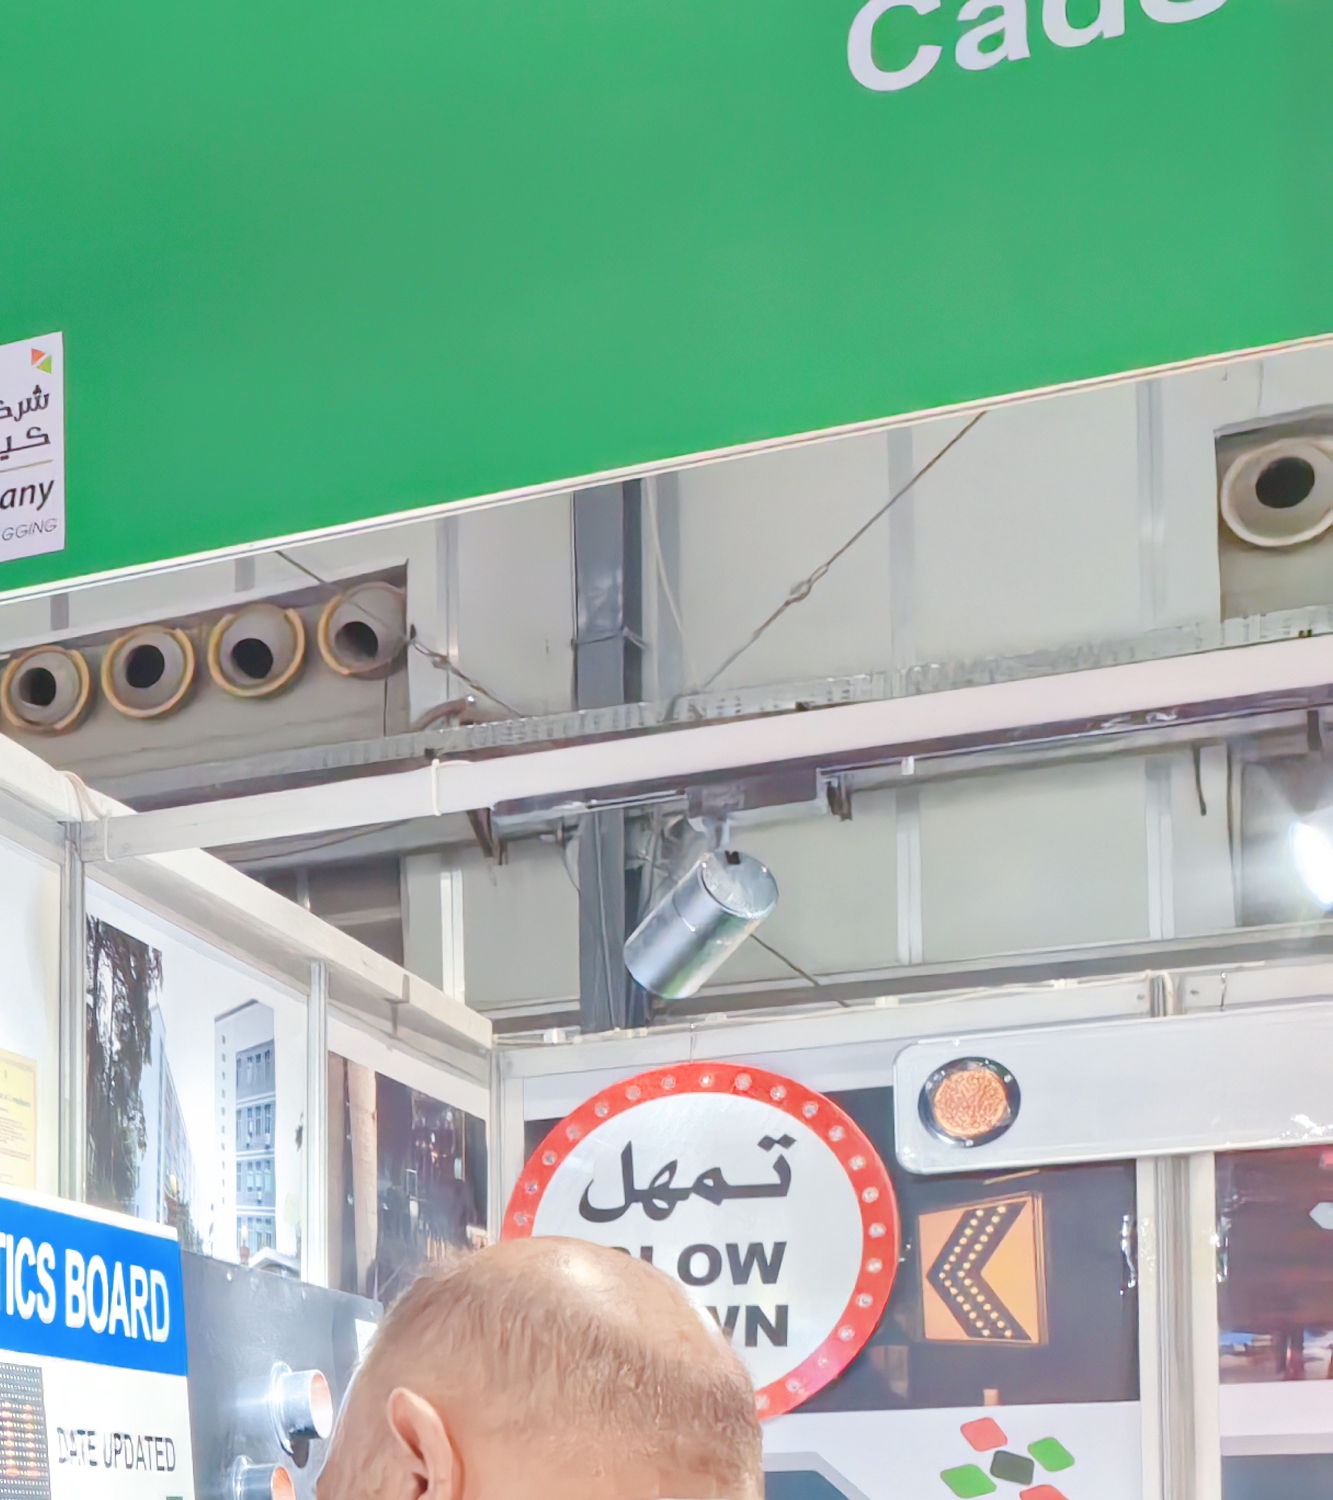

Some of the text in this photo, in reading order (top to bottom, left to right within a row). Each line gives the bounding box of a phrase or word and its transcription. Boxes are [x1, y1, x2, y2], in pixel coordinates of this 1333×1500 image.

[847, 0, 1228, 92] Cad
[579, 1133, 798, 1223] تمهل
[64, 1248, 171, 1344] BOARD
[610, 1241, 787, 1287] OW
[57, 1427, 177, 1472] DATE UPDATED
